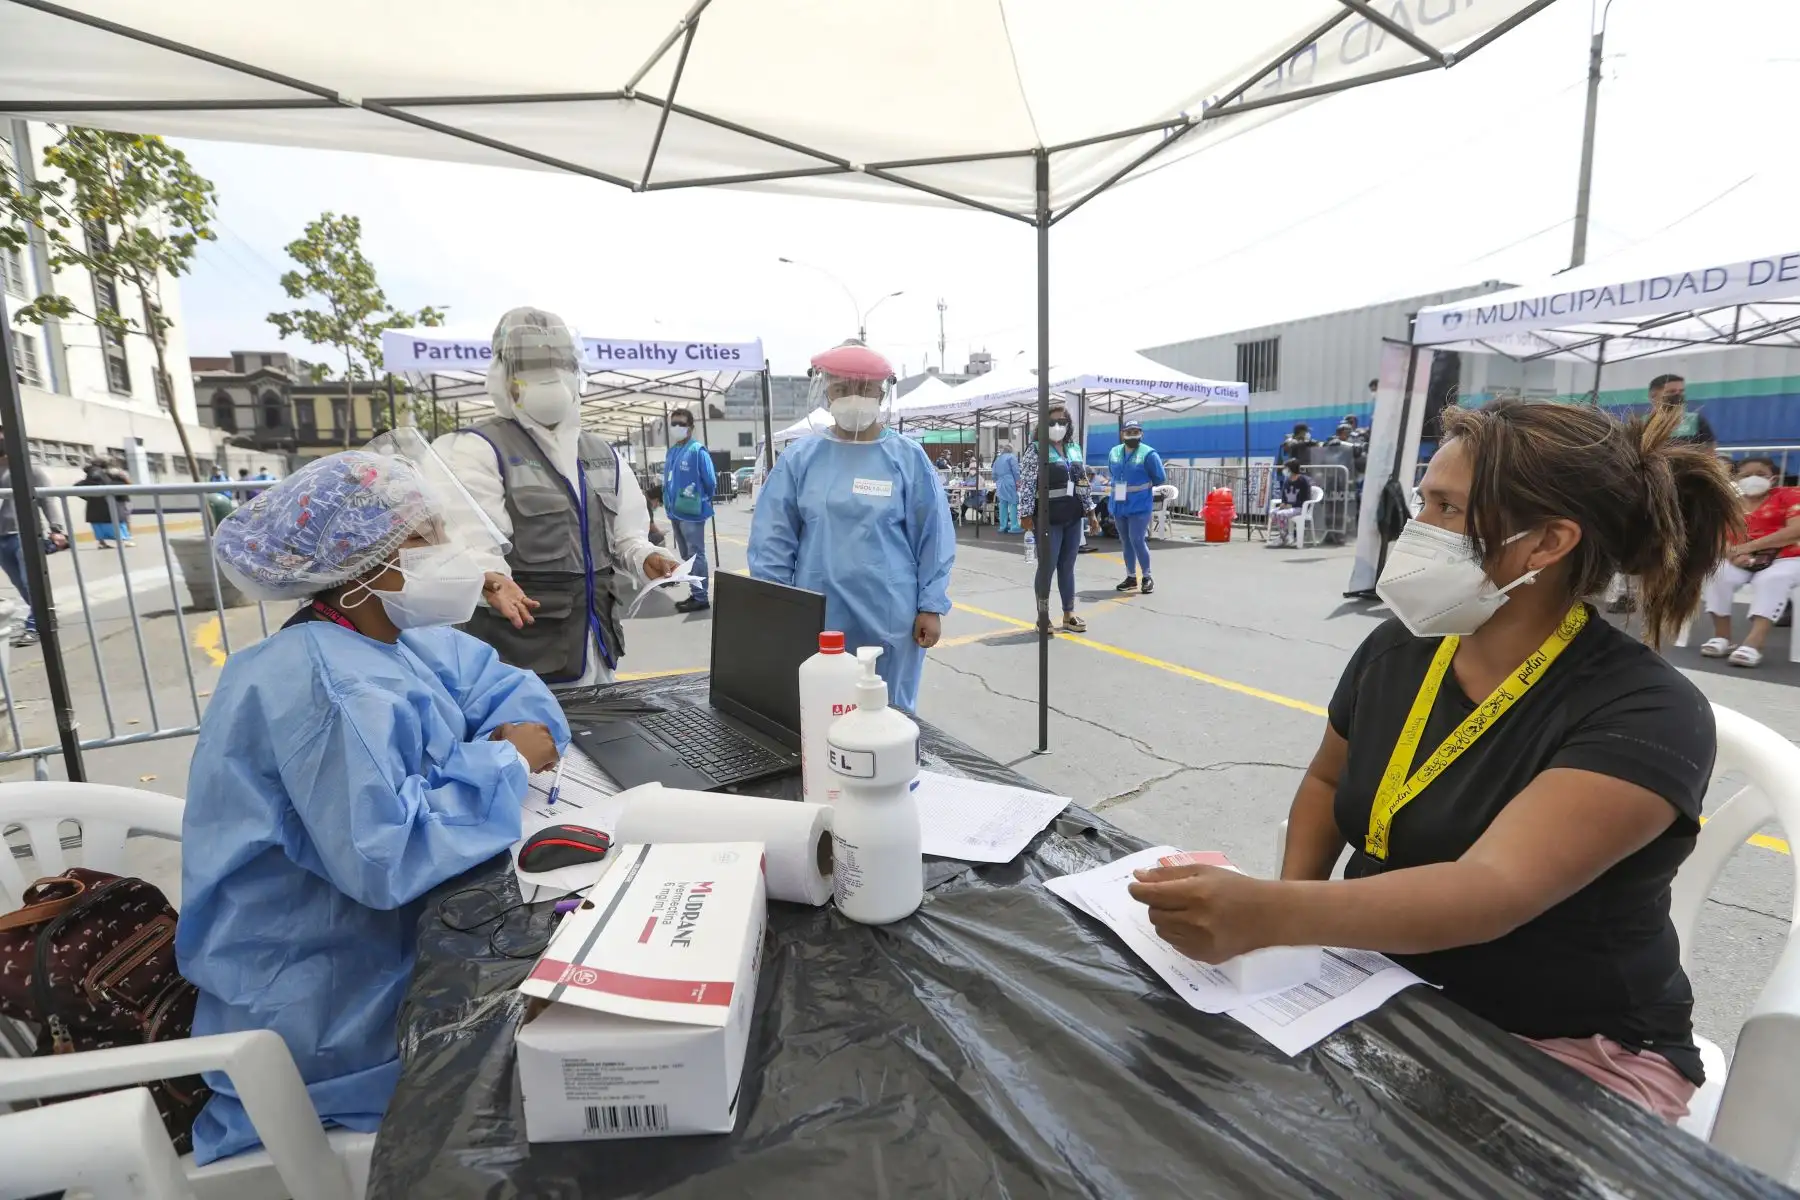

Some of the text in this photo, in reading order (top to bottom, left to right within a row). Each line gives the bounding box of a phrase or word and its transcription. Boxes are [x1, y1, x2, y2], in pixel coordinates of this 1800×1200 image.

[1476, 254, 1800, 325] MUNICIPALIDAD DE
[413, 341, 492, 359] Partne
[597, 343, 678, 364] Healthy
[685, 344, 741, 360] Cities
[1160, 380, 1174, 389] for
[1176, 382, 1212, 397] Healthy
[1214, 386, 1240, 399] Cities
[662, 881, 691, 925] Ivermectina
[670, 881, 715, 948] MUDRANE
